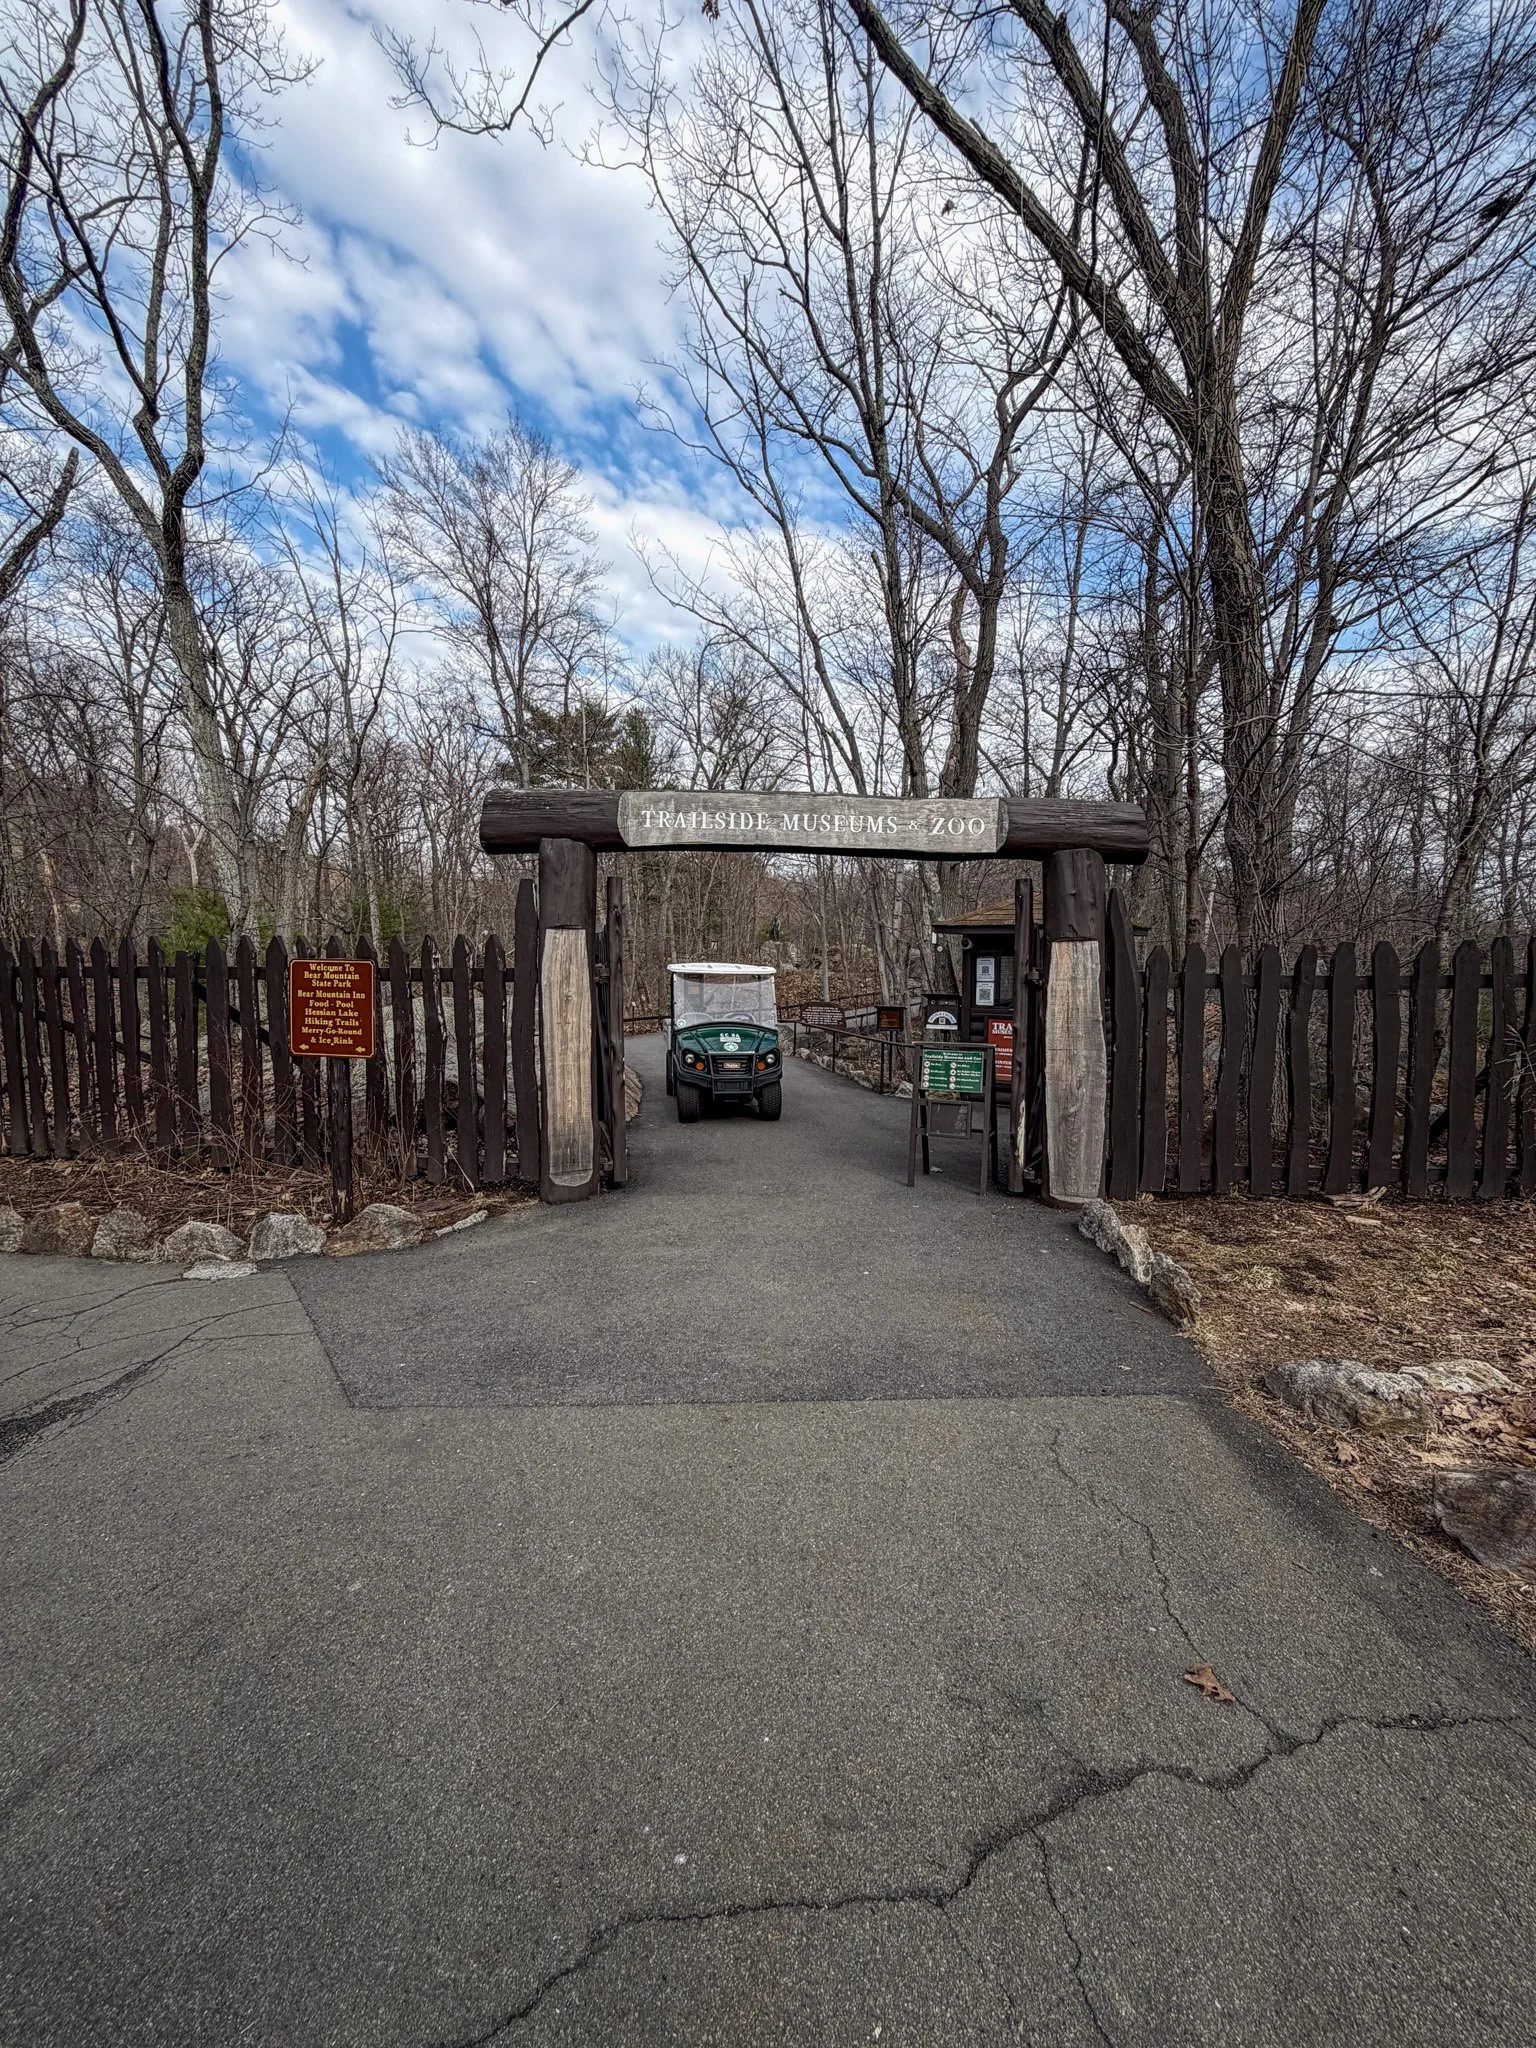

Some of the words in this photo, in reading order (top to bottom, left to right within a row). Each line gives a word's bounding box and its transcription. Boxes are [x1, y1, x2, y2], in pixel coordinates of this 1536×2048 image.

[642, 810, 769, 830] TRAILSIDE
[783, 813, 898, 834] MUSEUMS
[908, 820, 922, 831] &
[931, 817, 986, 835] ZOO
[309, 963, 343, 972] Welcome
[344, 963, 355, 972] To
[304, 971, 321, 979] Bear
[323, 972, 360, 980] Mountain
[297, 990, 314, 998] Bear
[316, 990, 351, 998] Mountain
[352, 991, 366, 999] Inn
[305, 1008, 336, 1016] Hessian
[338, 1009, 359, 1017] Lake
[304, 1018, 333, 1027] Hiking
[992, 1022, 1013, 1030] TRA
[302, 1027, 362, 1036] Merry-Go-Round
